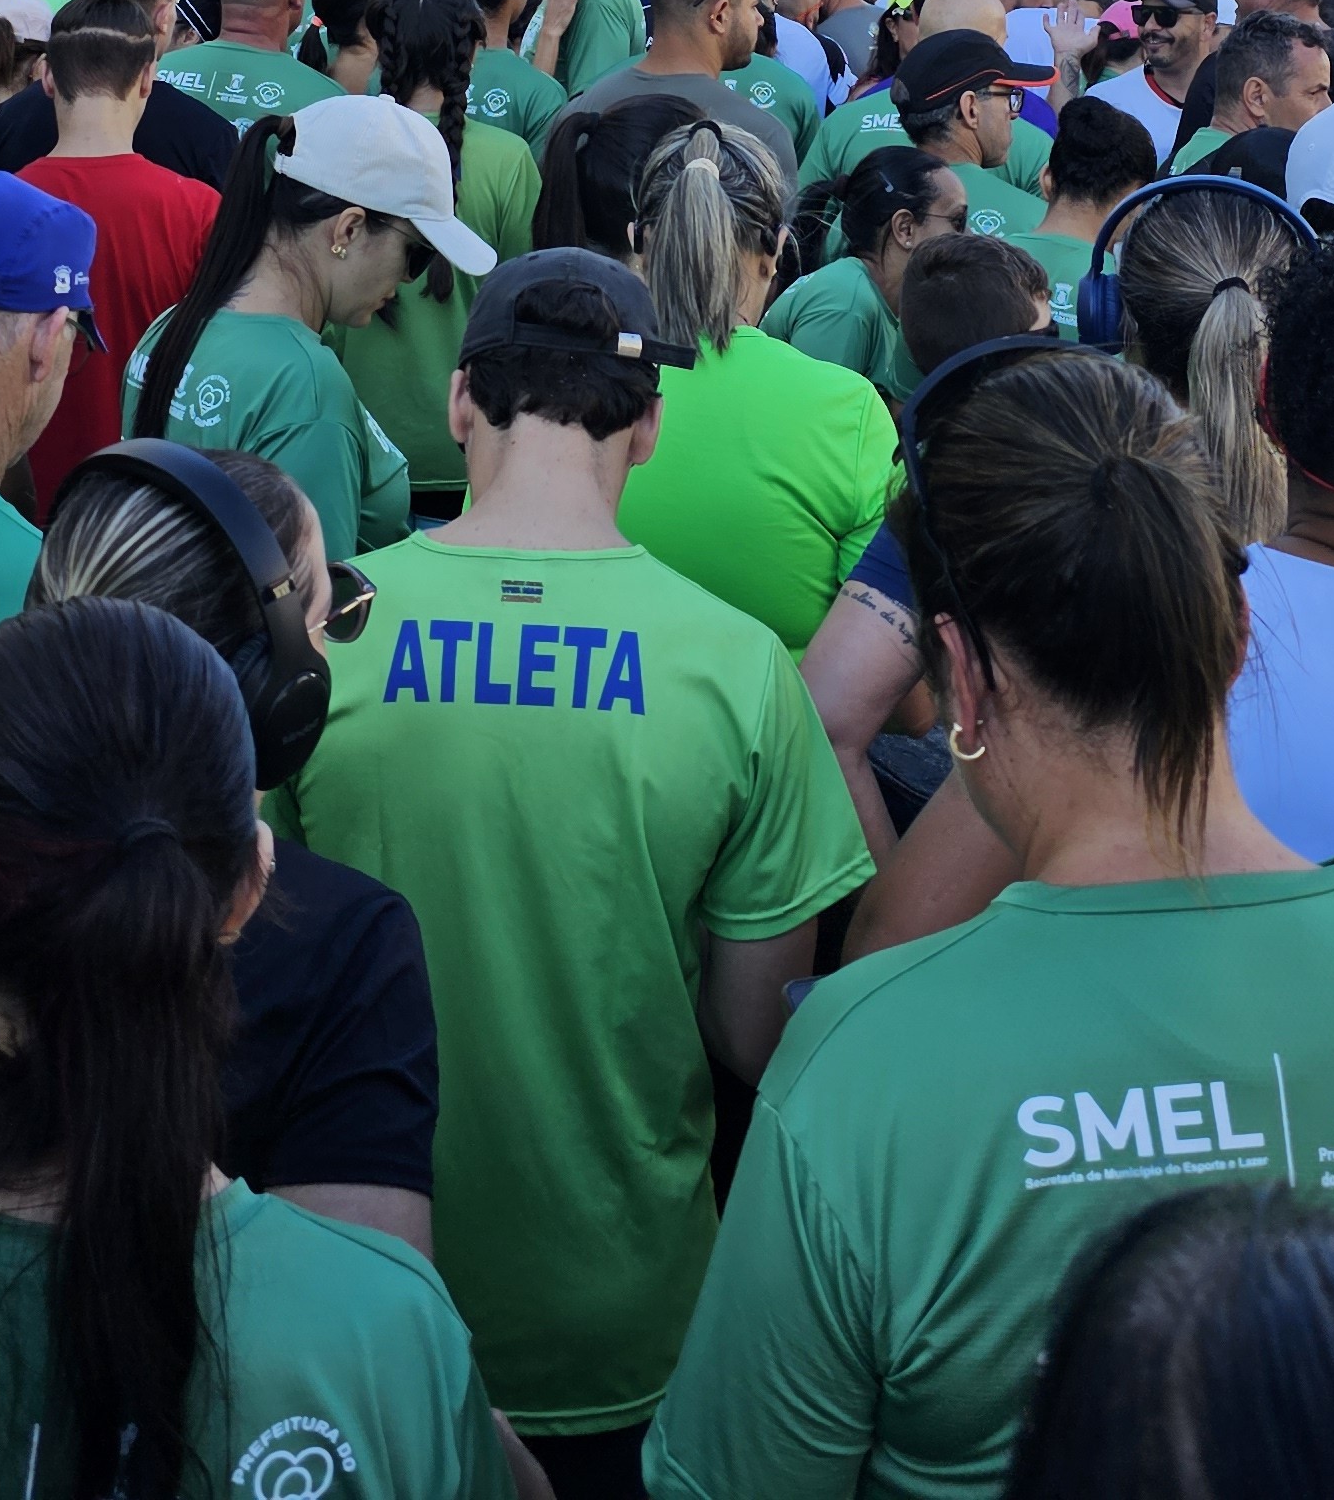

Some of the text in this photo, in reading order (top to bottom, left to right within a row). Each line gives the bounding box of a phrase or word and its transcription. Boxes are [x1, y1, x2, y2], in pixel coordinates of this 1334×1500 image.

[156, 69, 206, 89] SMEL
[860, 113, 903, 130] SME
[382, 619, 646, 716] ATLETA
[1016, 1080, 1265, 1168] SMEL
[1024, 1171, 1085, 1190] Secretaria
[1086, 1169, 1103, 1182] de
[1182, 1158, 1227, 1174] Esporte
[231, 1415, 357, 1486] PREFEITURA DO
